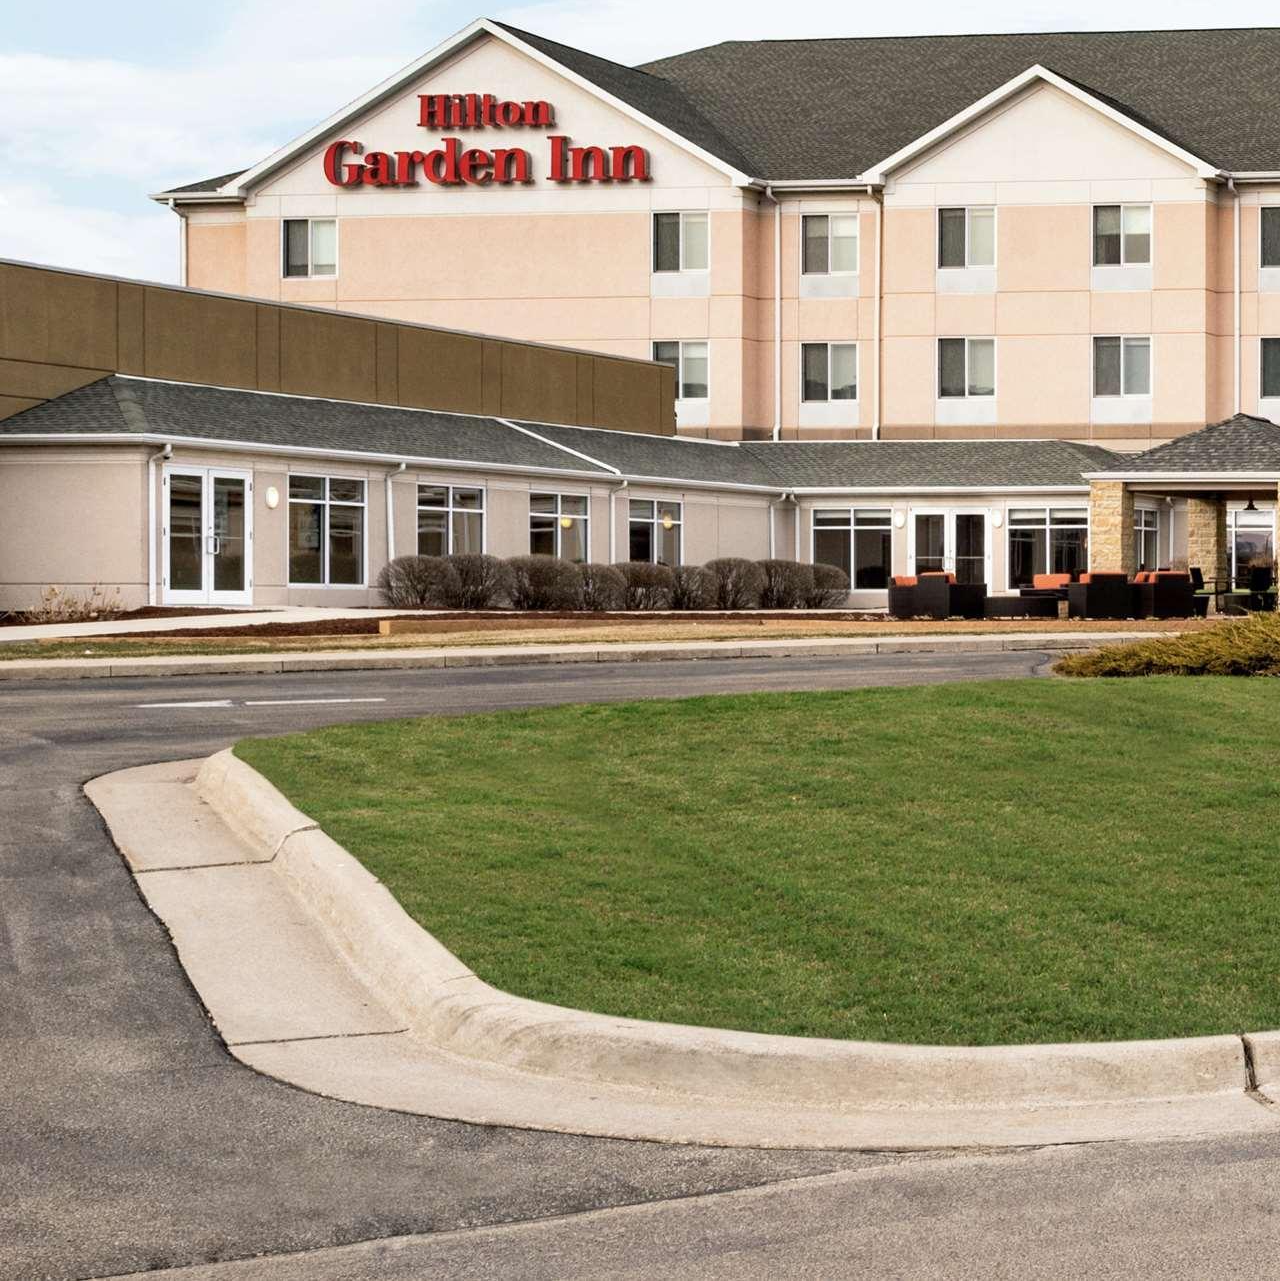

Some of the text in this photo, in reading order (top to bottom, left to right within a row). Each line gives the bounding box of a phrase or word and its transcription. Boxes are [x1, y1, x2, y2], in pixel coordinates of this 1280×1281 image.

[417, 93, 554, 128] Hilton
[324, 135, 651, 187] Garden Inn
